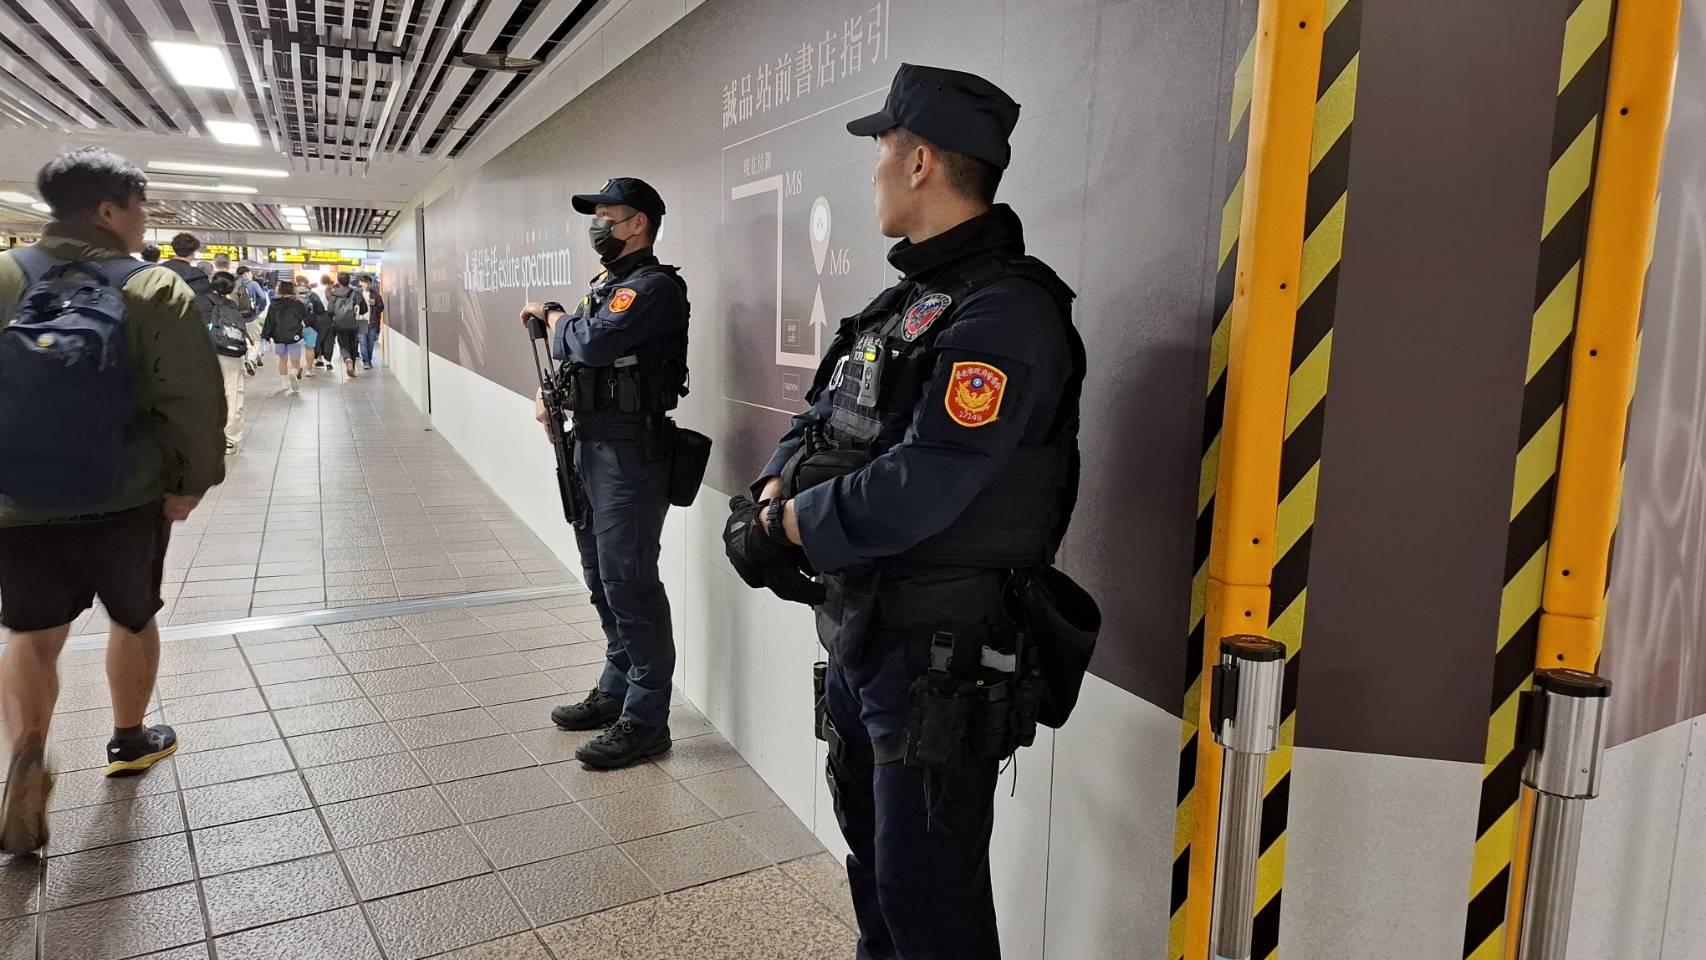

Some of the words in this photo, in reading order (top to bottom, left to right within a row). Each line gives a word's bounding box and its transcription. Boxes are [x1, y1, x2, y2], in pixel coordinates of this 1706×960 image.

[722, 0, 890, 130] 誠品站前書店指引
[785, 170, 802, 197] M8
[499, 243, 520, 288] eslite
[521, 247, 572, 304] spectrum
[830, 248, 850, 275] M6
